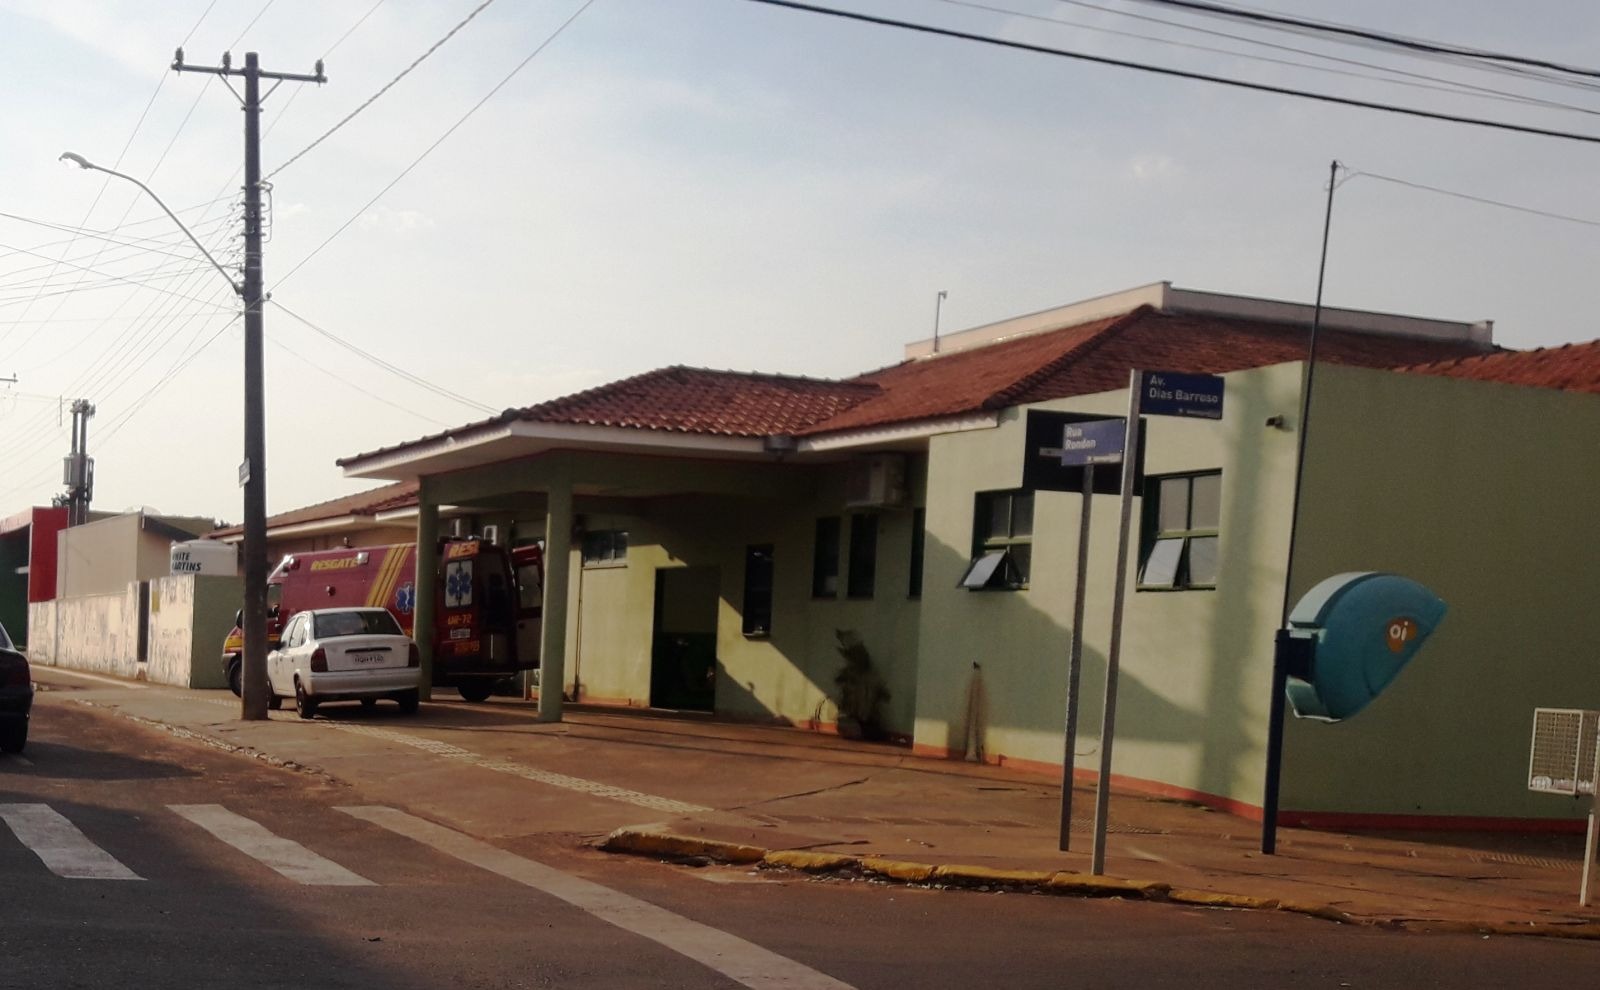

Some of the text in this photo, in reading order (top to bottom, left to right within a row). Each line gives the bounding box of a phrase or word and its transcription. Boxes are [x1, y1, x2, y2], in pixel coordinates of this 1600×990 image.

[1149, 374, 1167, 386] Av.
[1149, 387, 1219, 403] Dias Barroso
[1065, 426, 1083, 438] Rua
[1064, 438, 1097, 450] Rondon
[172, 561, 202, 572] ARTINS
